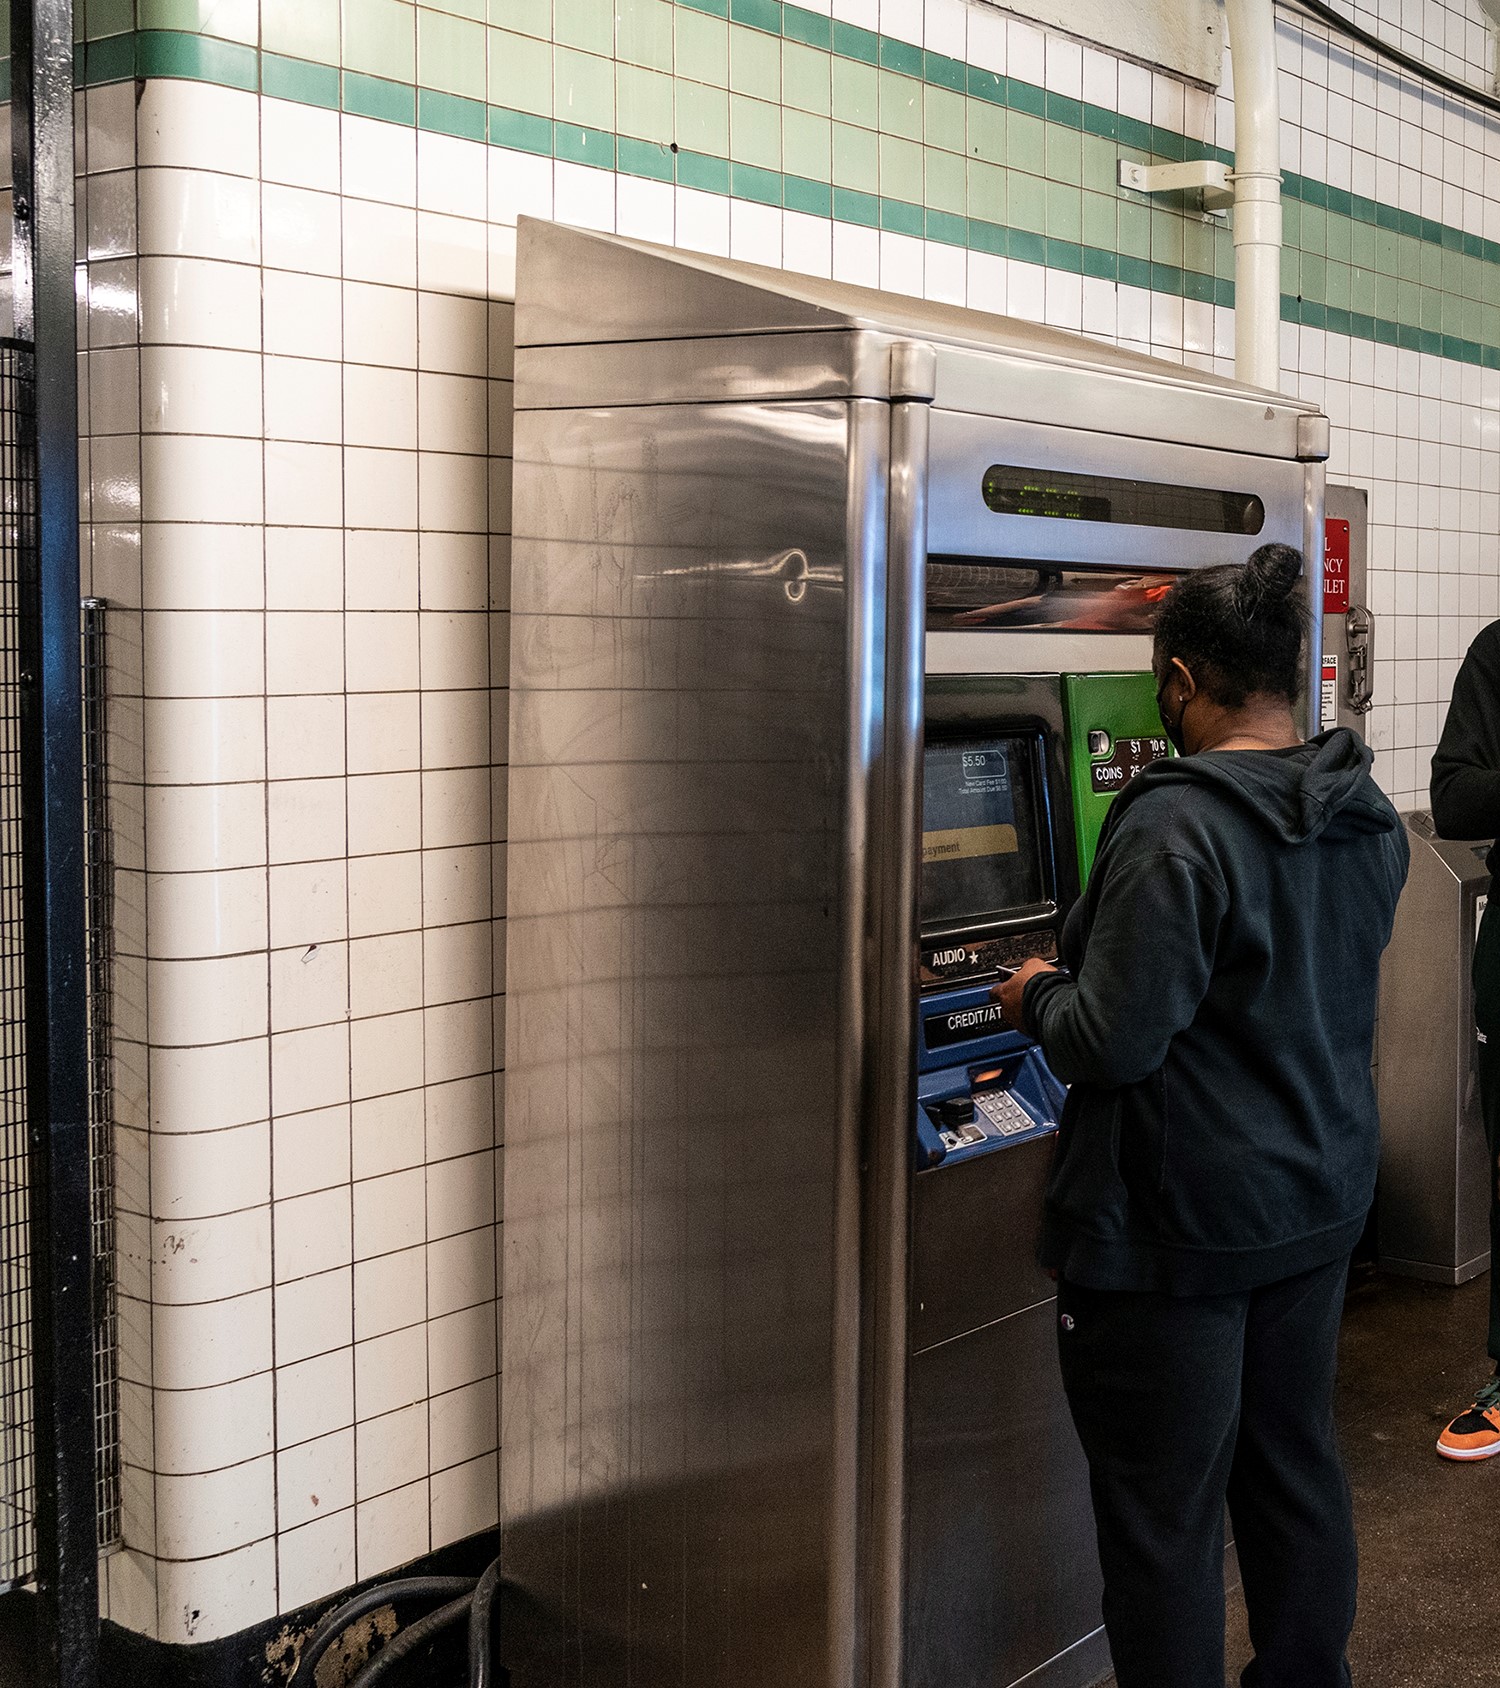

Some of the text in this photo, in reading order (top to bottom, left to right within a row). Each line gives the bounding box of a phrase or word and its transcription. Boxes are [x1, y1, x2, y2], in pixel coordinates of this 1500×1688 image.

[1130, 739, 1141, 754] $1
[962, 755, 986, 767] $5.50
[1096, 765, 1124, 781] COINS
[932, 948, 966, 967] AUDIO
[947, 1006, 1002, 1030] CREDIT/AT
